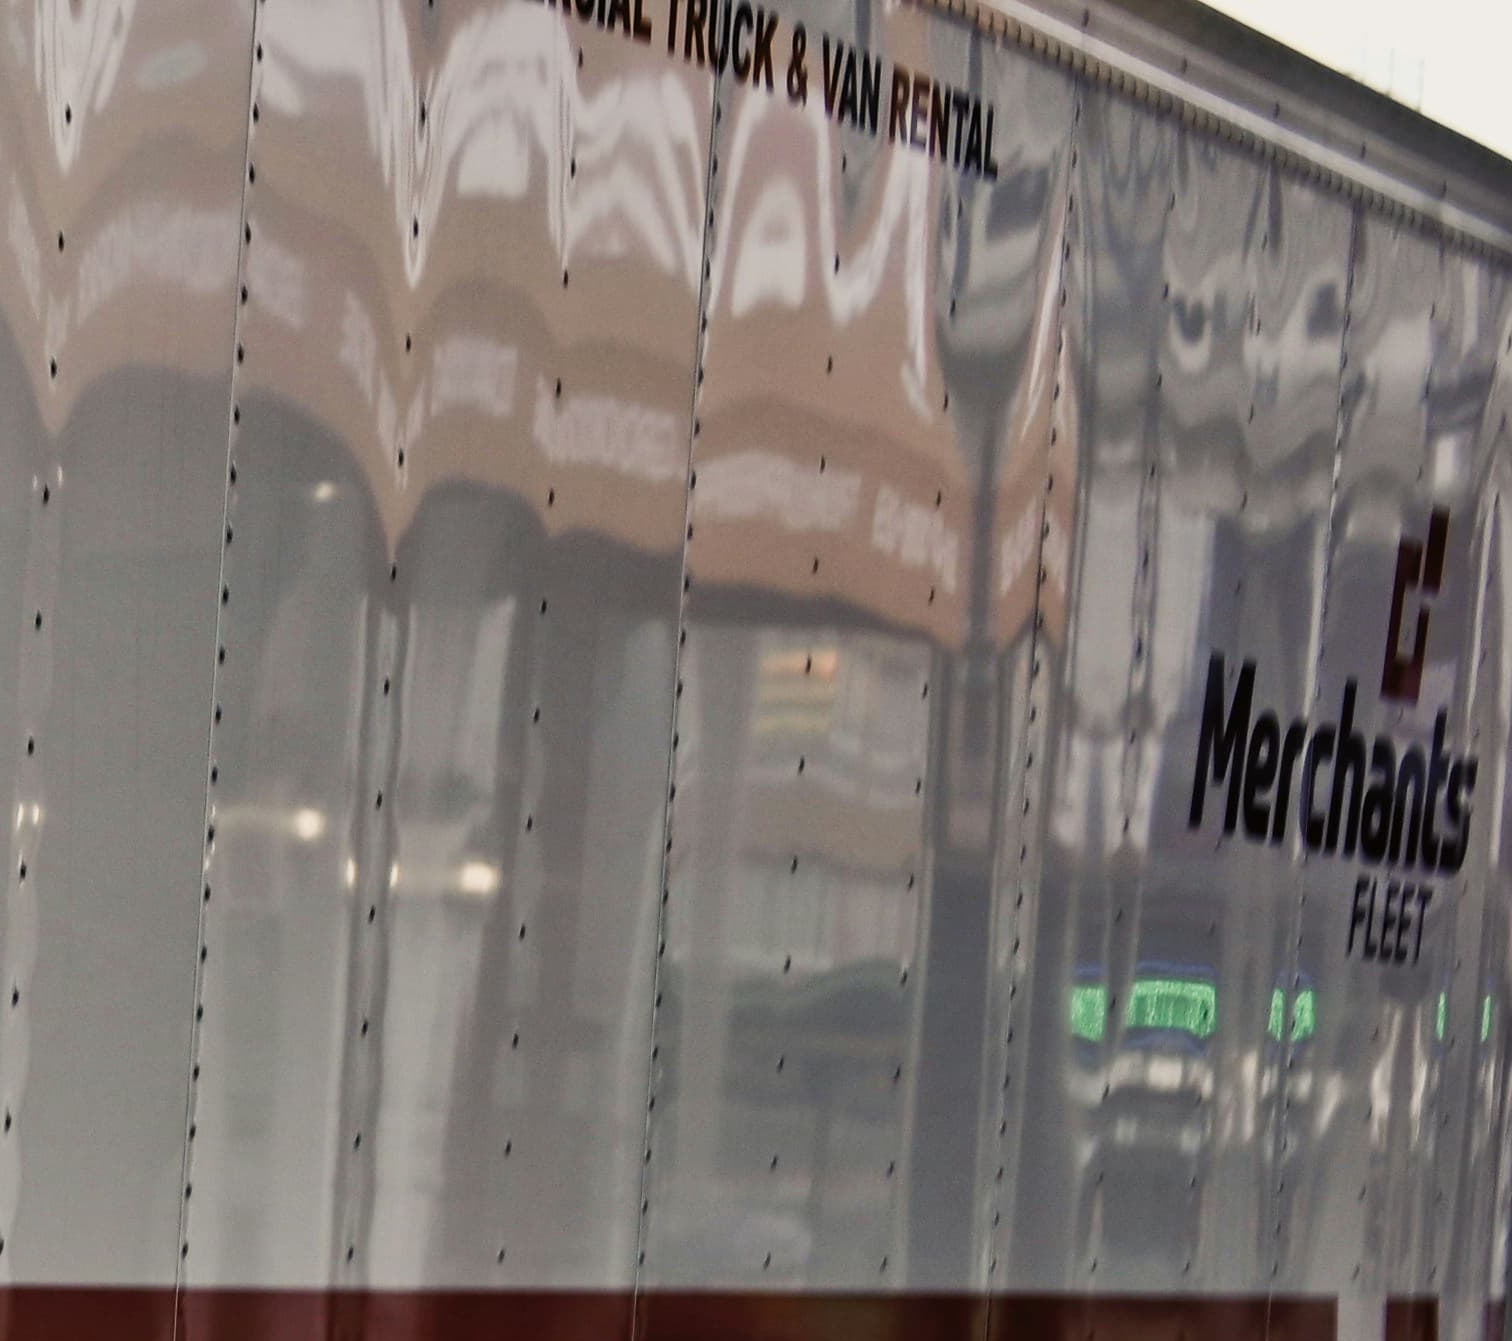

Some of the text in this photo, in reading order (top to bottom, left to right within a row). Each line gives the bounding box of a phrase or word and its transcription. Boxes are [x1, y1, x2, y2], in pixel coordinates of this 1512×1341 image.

[667, 0, 779, 93] TRUCK
[786, 20, 808, 111] &
[822, 31, 882, 139] VAN
[888, 62, 998, 182] RENTAL
[1187, 652, 1479, 874] Merchants
[1346, 876, 1434, 965] FLEET
